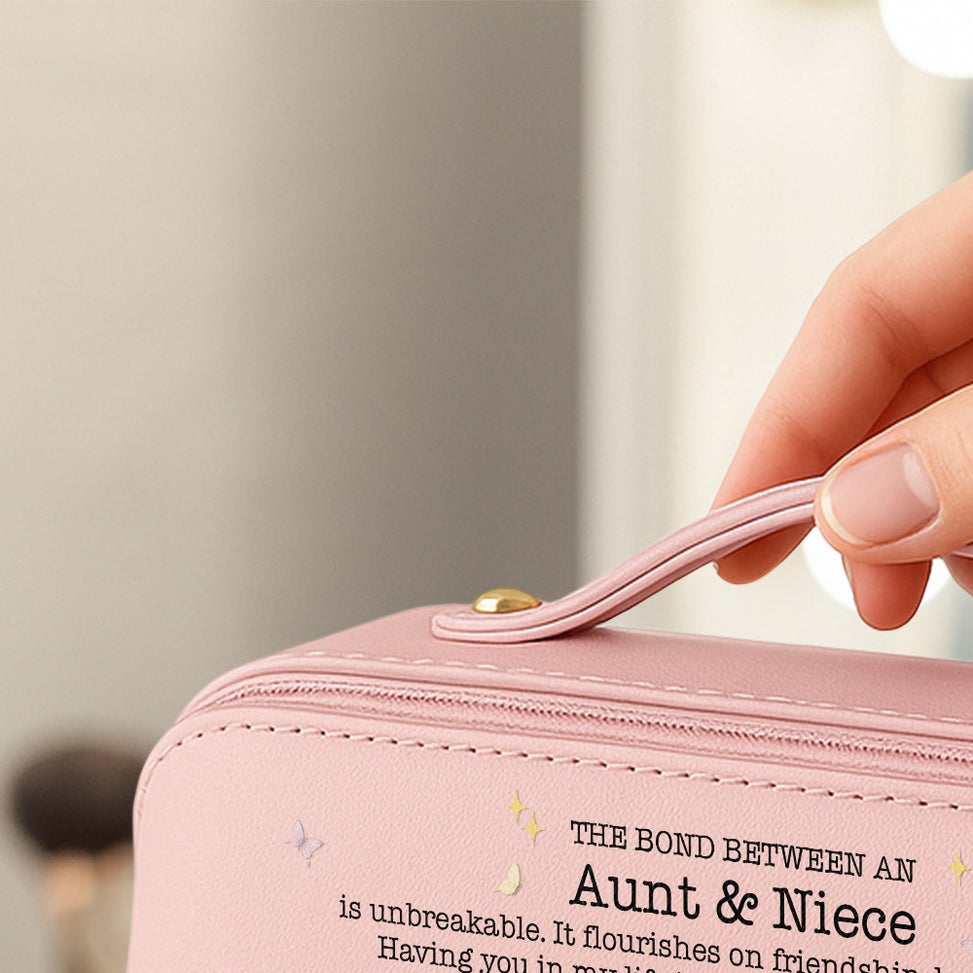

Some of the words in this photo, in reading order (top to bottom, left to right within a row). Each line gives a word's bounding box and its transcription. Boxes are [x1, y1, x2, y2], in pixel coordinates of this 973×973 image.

[570, 819, 627, 850] THE
[634, 827, 715, 860] BOND
[722, 837, 867, 878] BETWEEN
[872, 855, 917, 884] AN
[339, 893, 362, 920] is
[369, 902, 546, 943] unbreakable.
[552, 920, 576, 947] It
[582, 924, 721, 964] flourishes
[729, 947, 765, 970] on
[568, 863, 701, 920] Aunt
[716, 879, 759, 926] &
[772, 886, 916, 946] Niece
